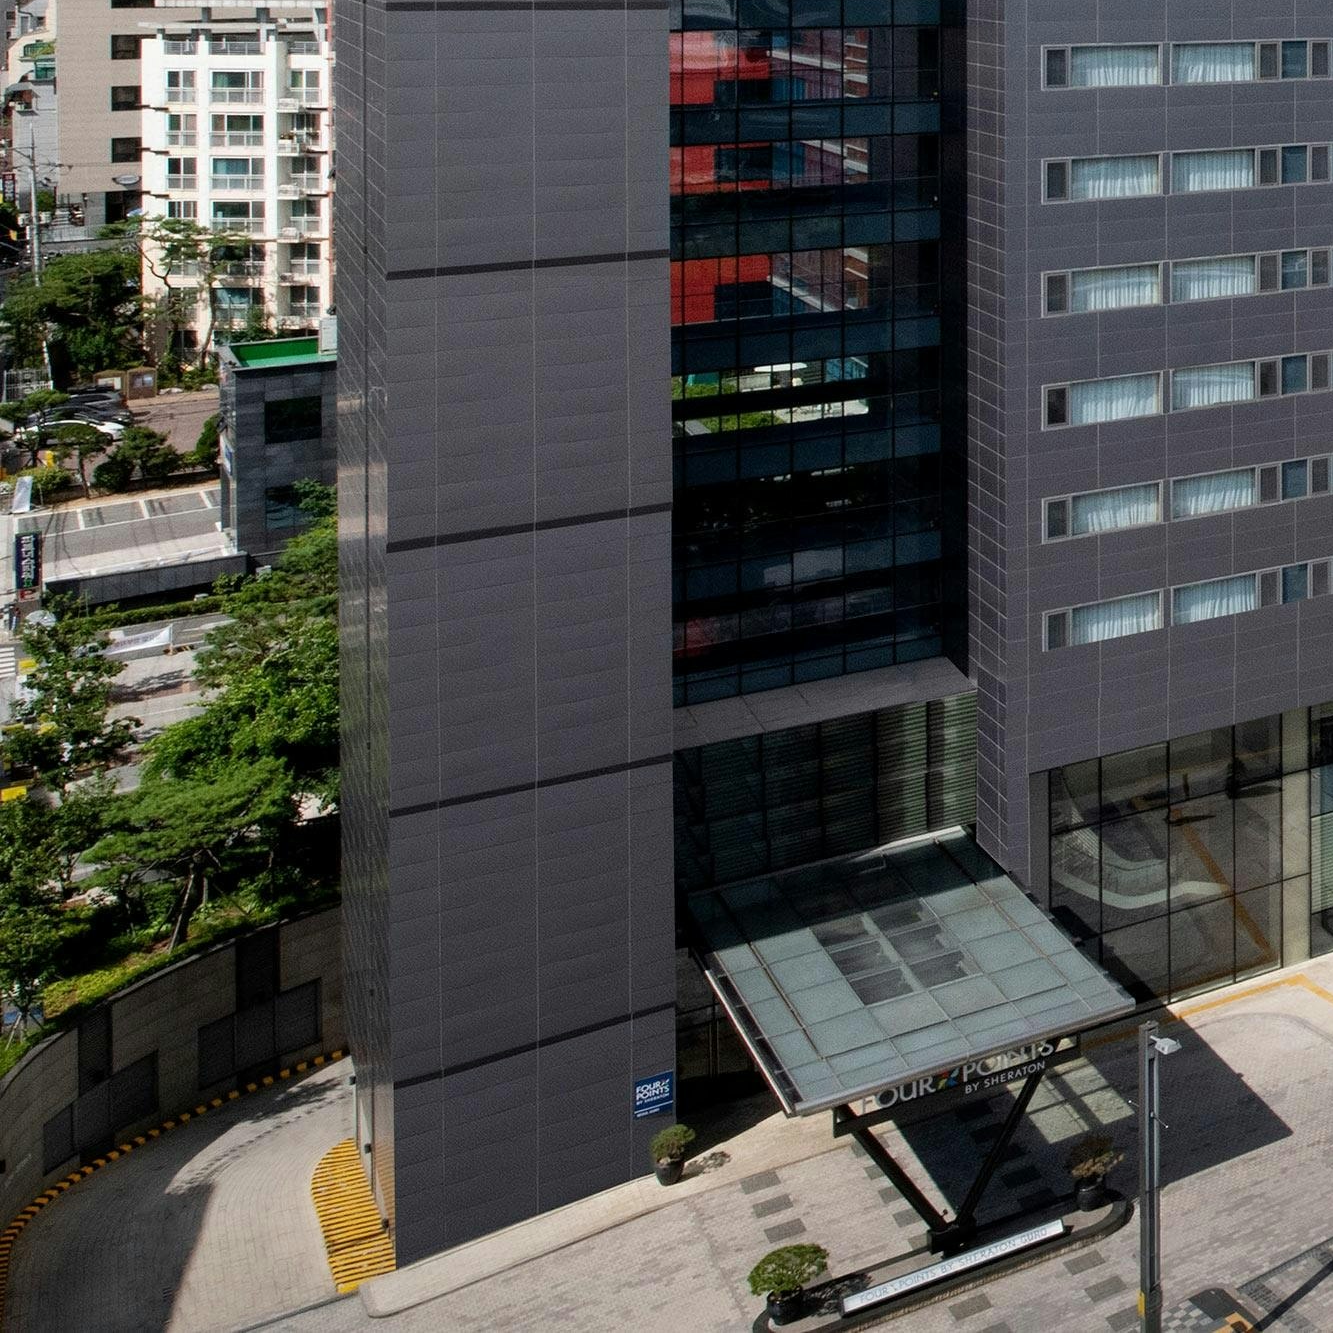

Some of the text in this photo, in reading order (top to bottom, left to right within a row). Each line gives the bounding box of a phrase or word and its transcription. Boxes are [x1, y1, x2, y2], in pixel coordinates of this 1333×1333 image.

[636, 1080, 662, 1094] FOUR
[636, 1085, 670, 1101] POINTS
[860, 1040, 1054, 1113] FOUR POINTS
[965, 1061, 1045, 1095] BY SHERATON
[859, 1227, 1048, 1304] FOUR POINTS BY SHERATON GURO
